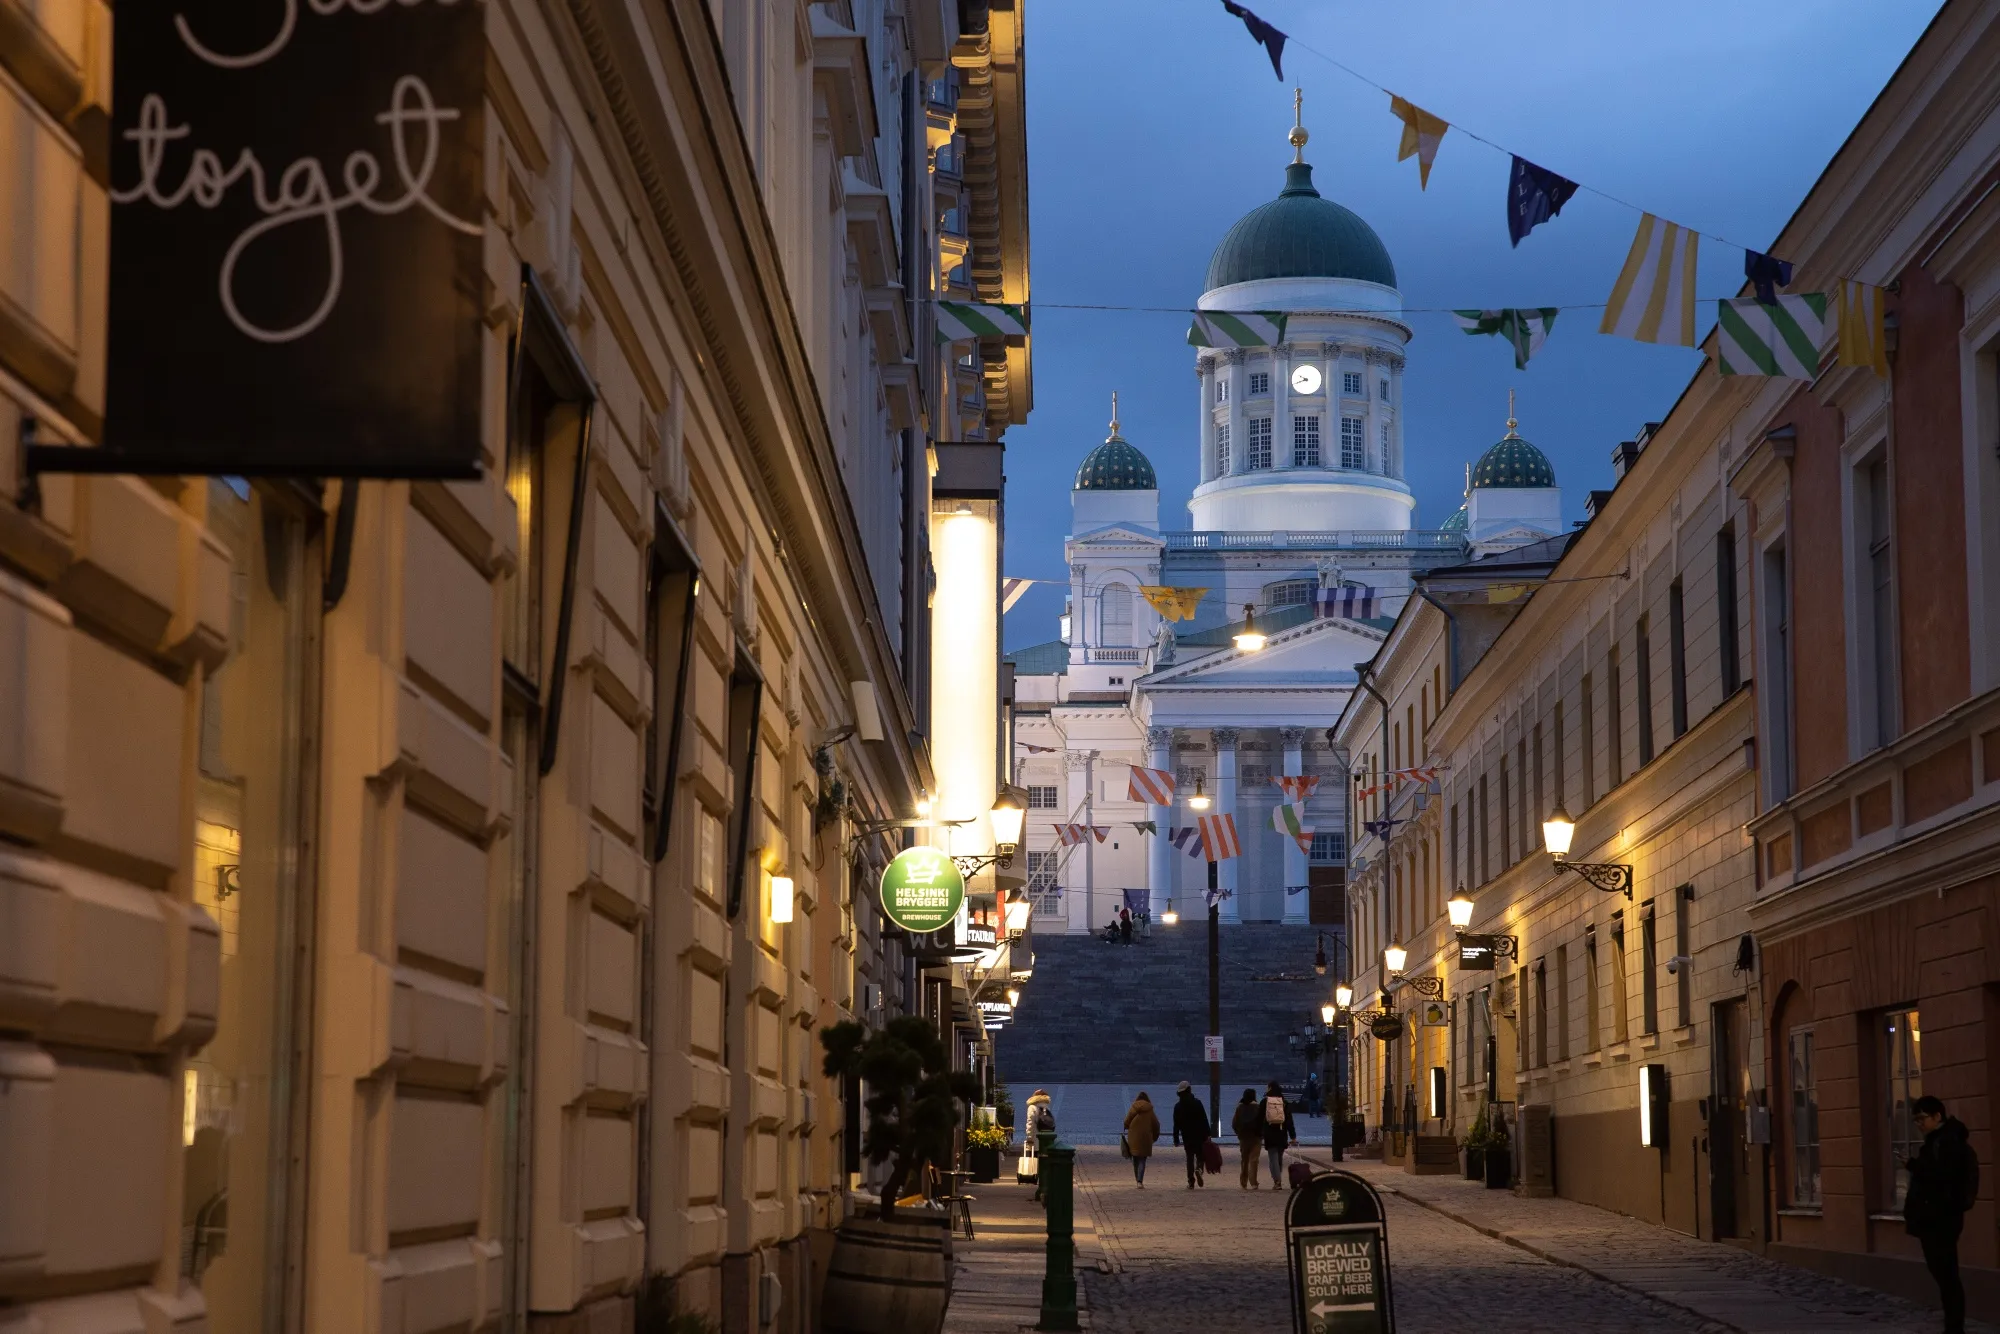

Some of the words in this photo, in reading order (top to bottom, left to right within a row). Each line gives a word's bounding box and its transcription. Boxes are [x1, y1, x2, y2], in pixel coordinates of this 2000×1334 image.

[110, 75, 483, 342] torget
[896, 888, 949, 898] HELSINKI
[896, 897, 949, 907] BRYGGERI
[1305, 1242, 1370, 1259] LOCALLY
[1307, 1257, 1371, 1274] BREWED
[1308, 1273, 1343, 1285] CRAFT
[1344, 1272, 1372, 1283] BEER
[1309, 1285, 1338, 1297] SOLD
[1342, 1284, 1373, 1295] HERE
